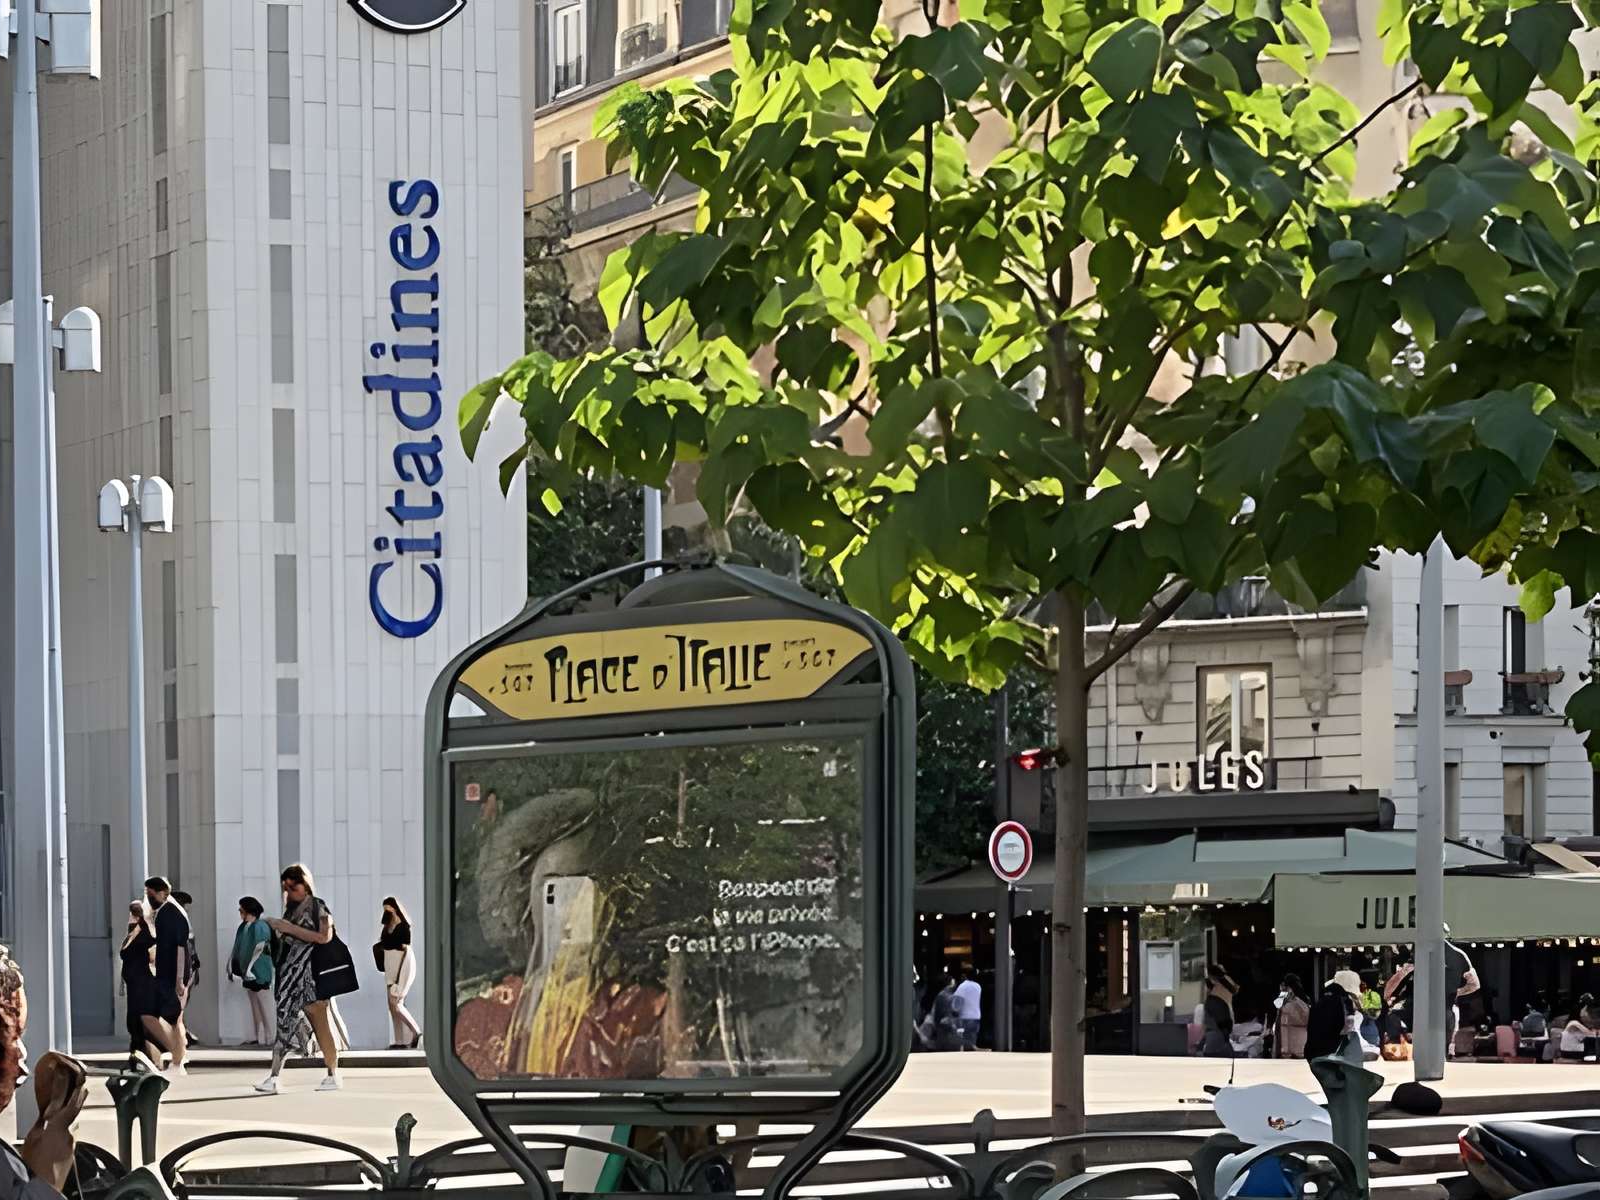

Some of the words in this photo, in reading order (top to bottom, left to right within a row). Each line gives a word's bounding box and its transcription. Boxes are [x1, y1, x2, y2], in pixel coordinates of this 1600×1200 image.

[363, 179, 444, 639] Citadines
[544, 645, 640, 704] PLACE
[1142, 750, 1265, 794] JULES
[1356, 895, 1416, 930] JULE
